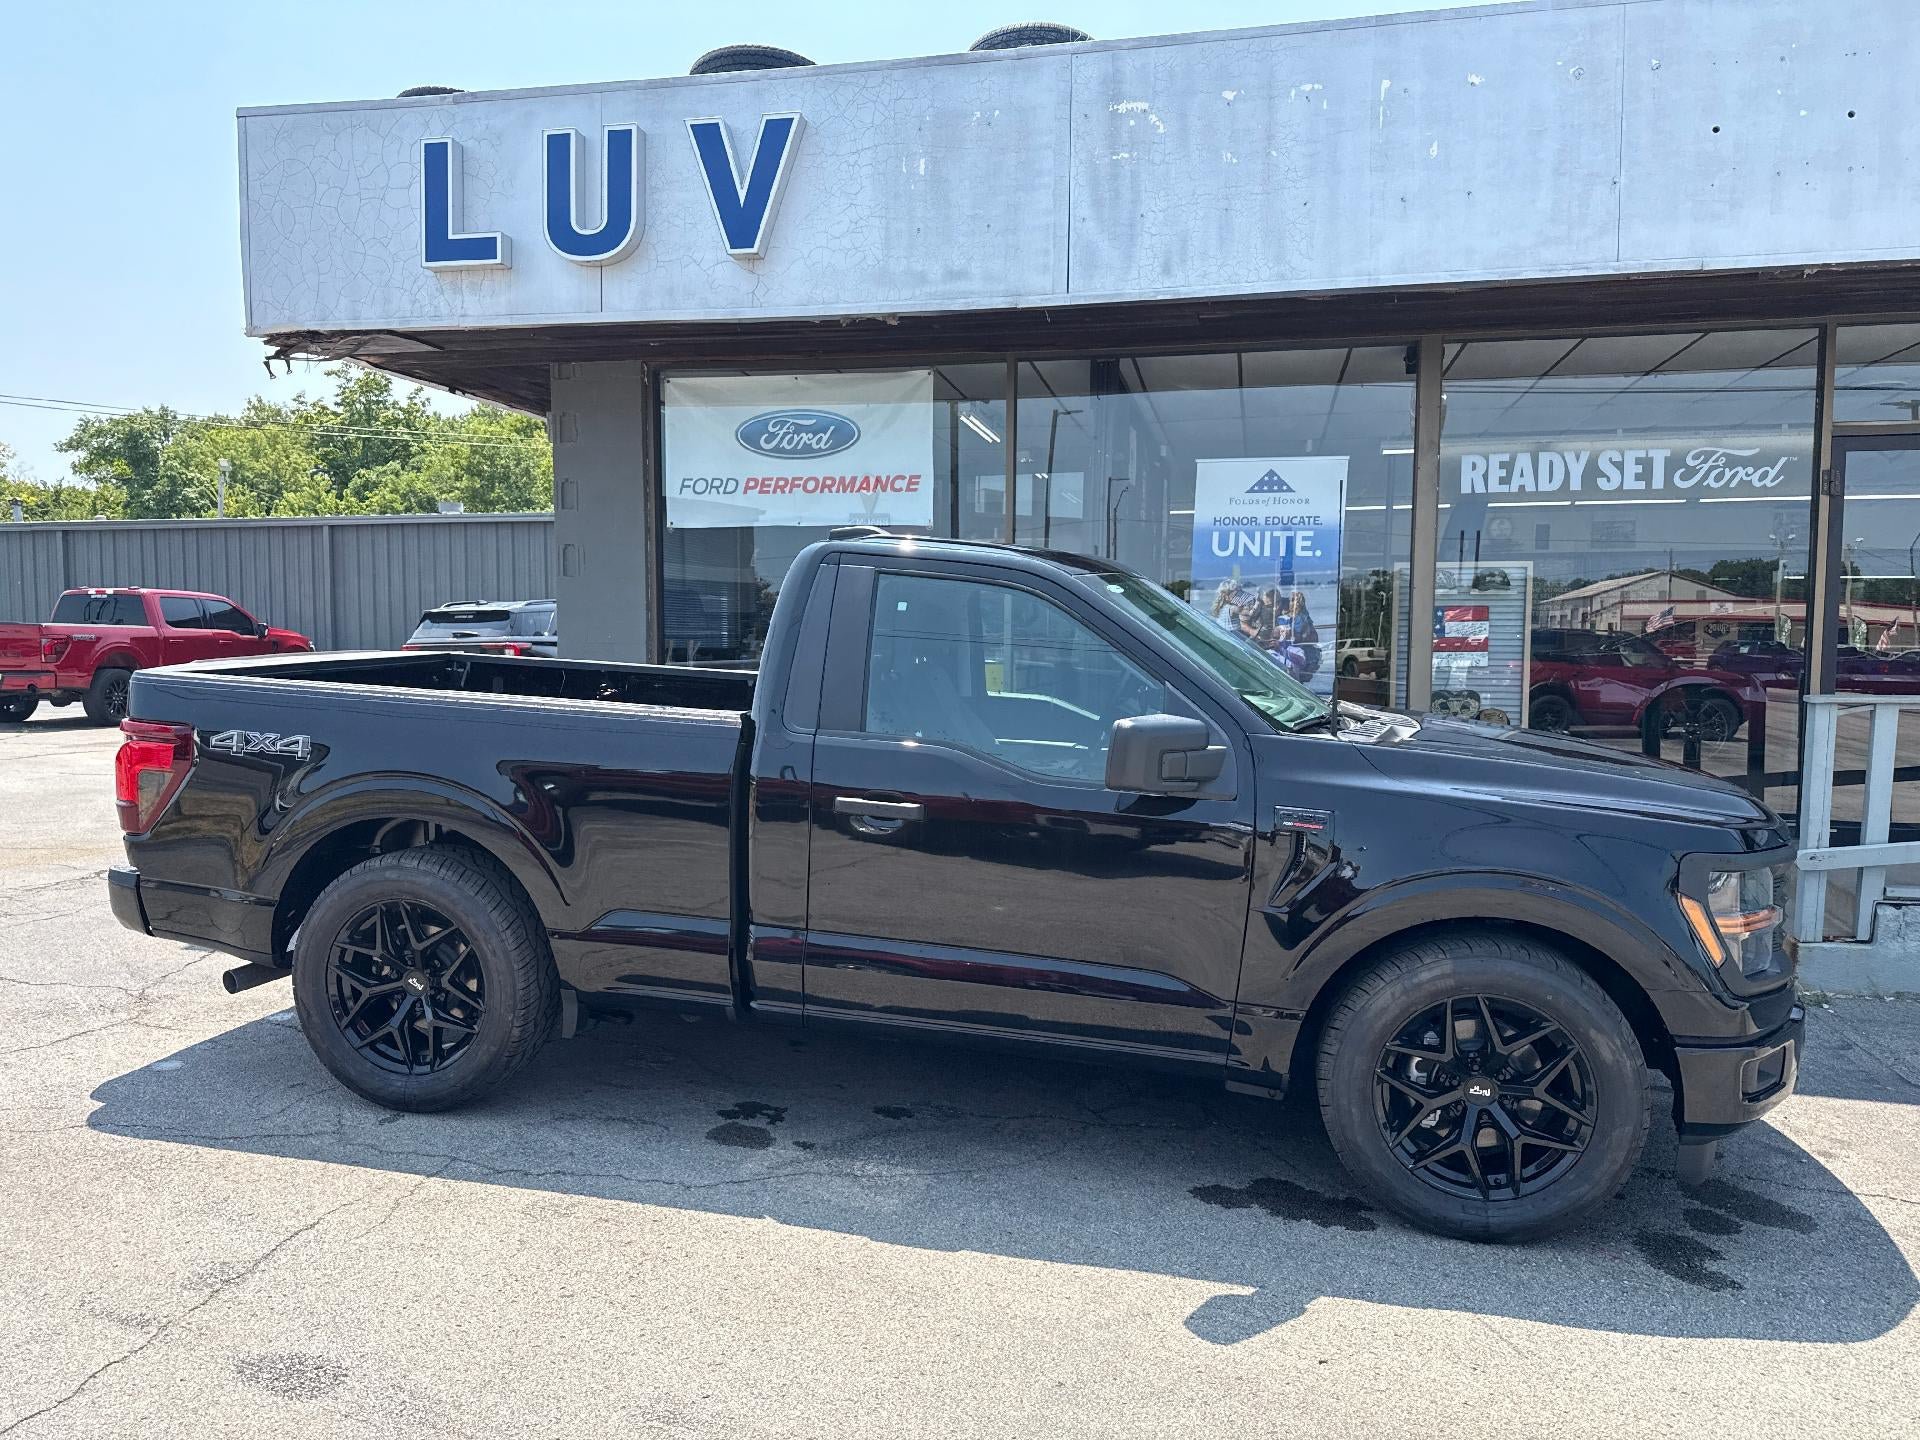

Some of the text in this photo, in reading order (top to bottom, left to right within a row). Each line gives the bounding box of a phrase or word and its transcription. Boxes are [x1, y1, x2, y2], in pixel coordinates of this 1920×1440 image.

[420, 111, 807, 272] LUV
[759, 418, 834, 450] Ford
[679, 474, 922, 495] FORD PERFORMANCE
[1460, 450, 1591, 495] READY
[1596, 448, 1671, 492] SET
[1673, 447, 1789, 489] Ford
[1261, 496, 1271, 507] of
[1272, 495, 1311, 506] HONOR
[1213, 515, 1323, 527] HONOR. EDUCATE.
[1211, 530, 1323, 558] UNITE.
